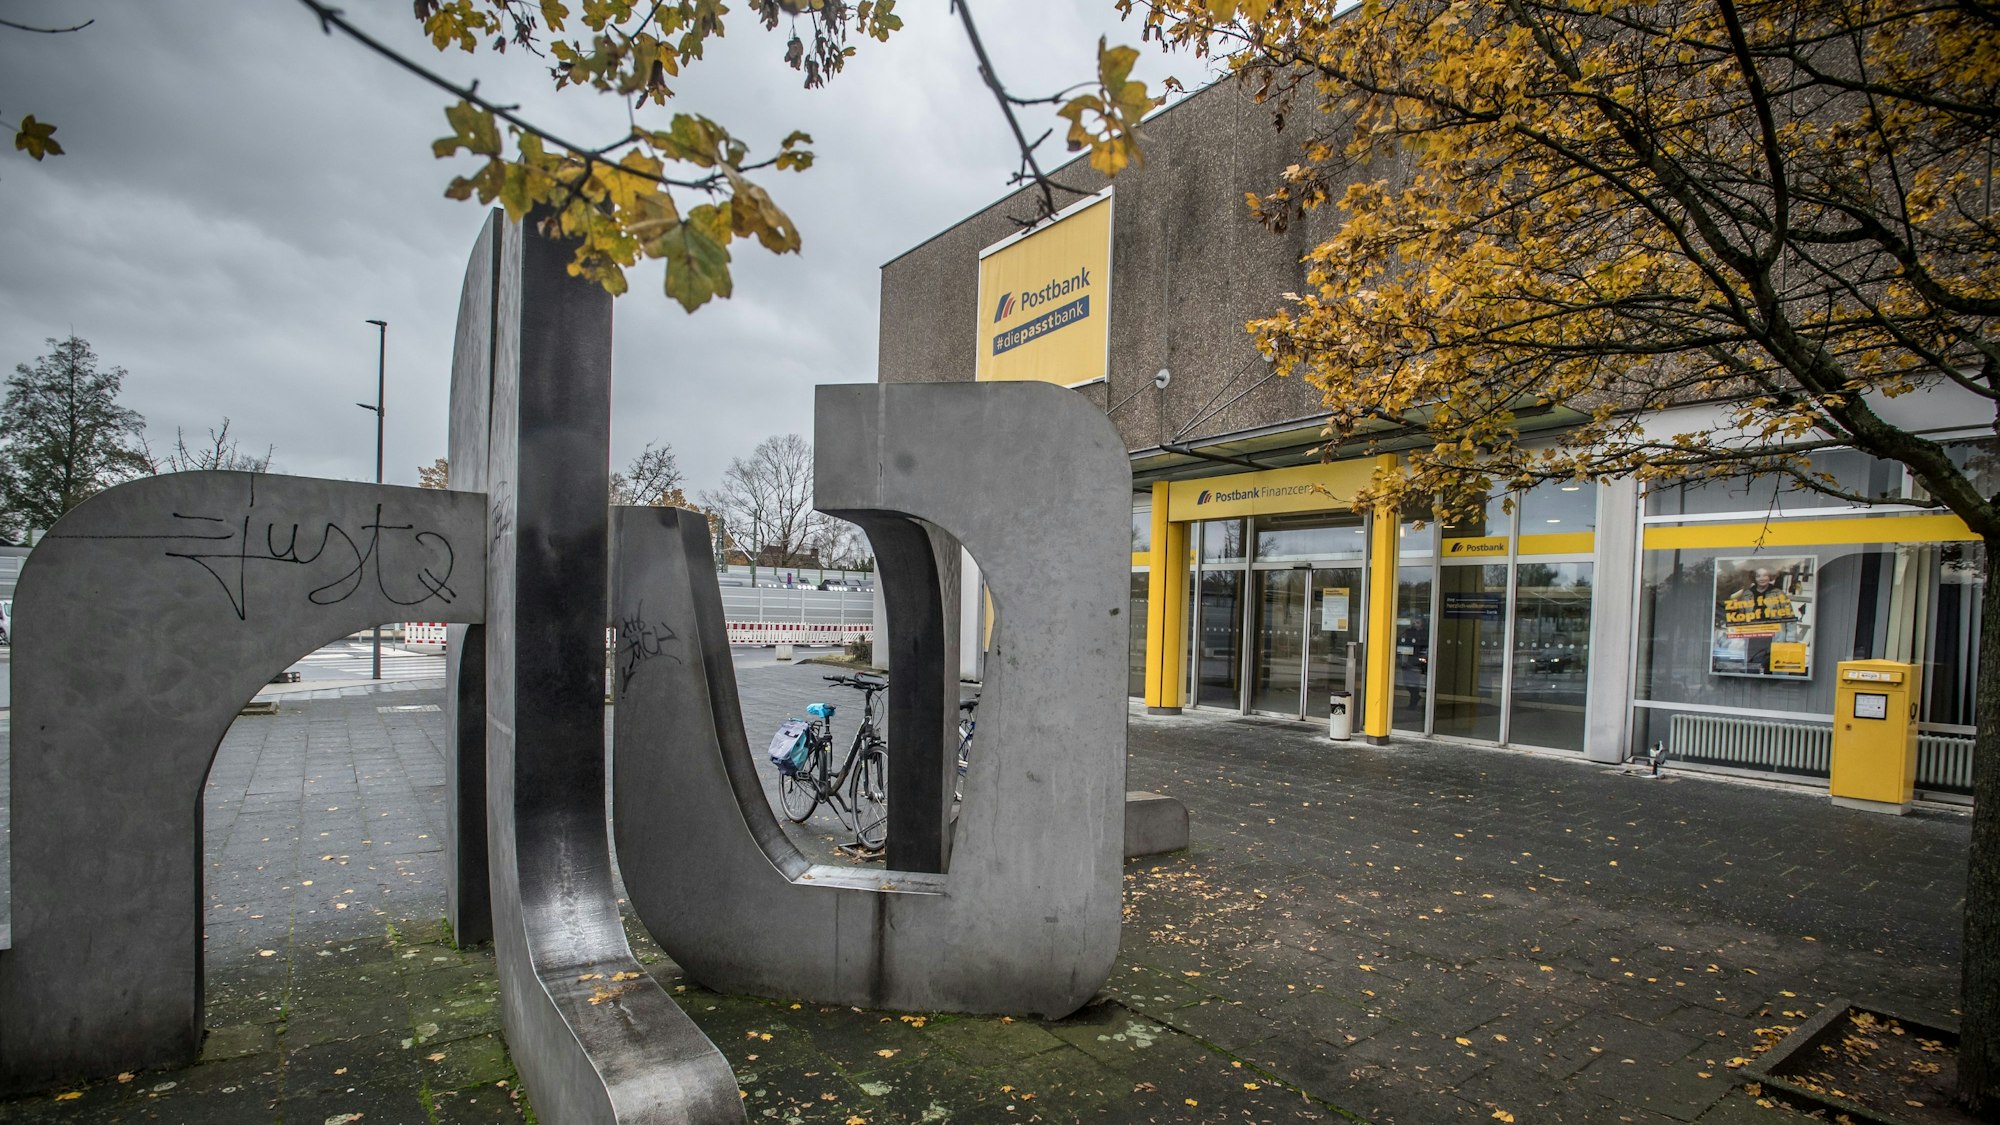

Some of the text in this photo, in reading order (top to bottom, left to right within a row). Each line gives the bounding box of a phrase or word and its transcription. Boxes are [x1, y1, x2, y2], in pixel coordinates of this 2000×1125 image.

[1021, 267, 1091, 311] Postbank
[997, 302, 1084, 350] #diepasstbank
[1216, 483, 1316, 502] Postbank Finanzcen
[1466, 543, 1504, 552] Postbank
[1724, 599, 1755, 610] Zins
[1726, 608, 1762, 622] Kopf
